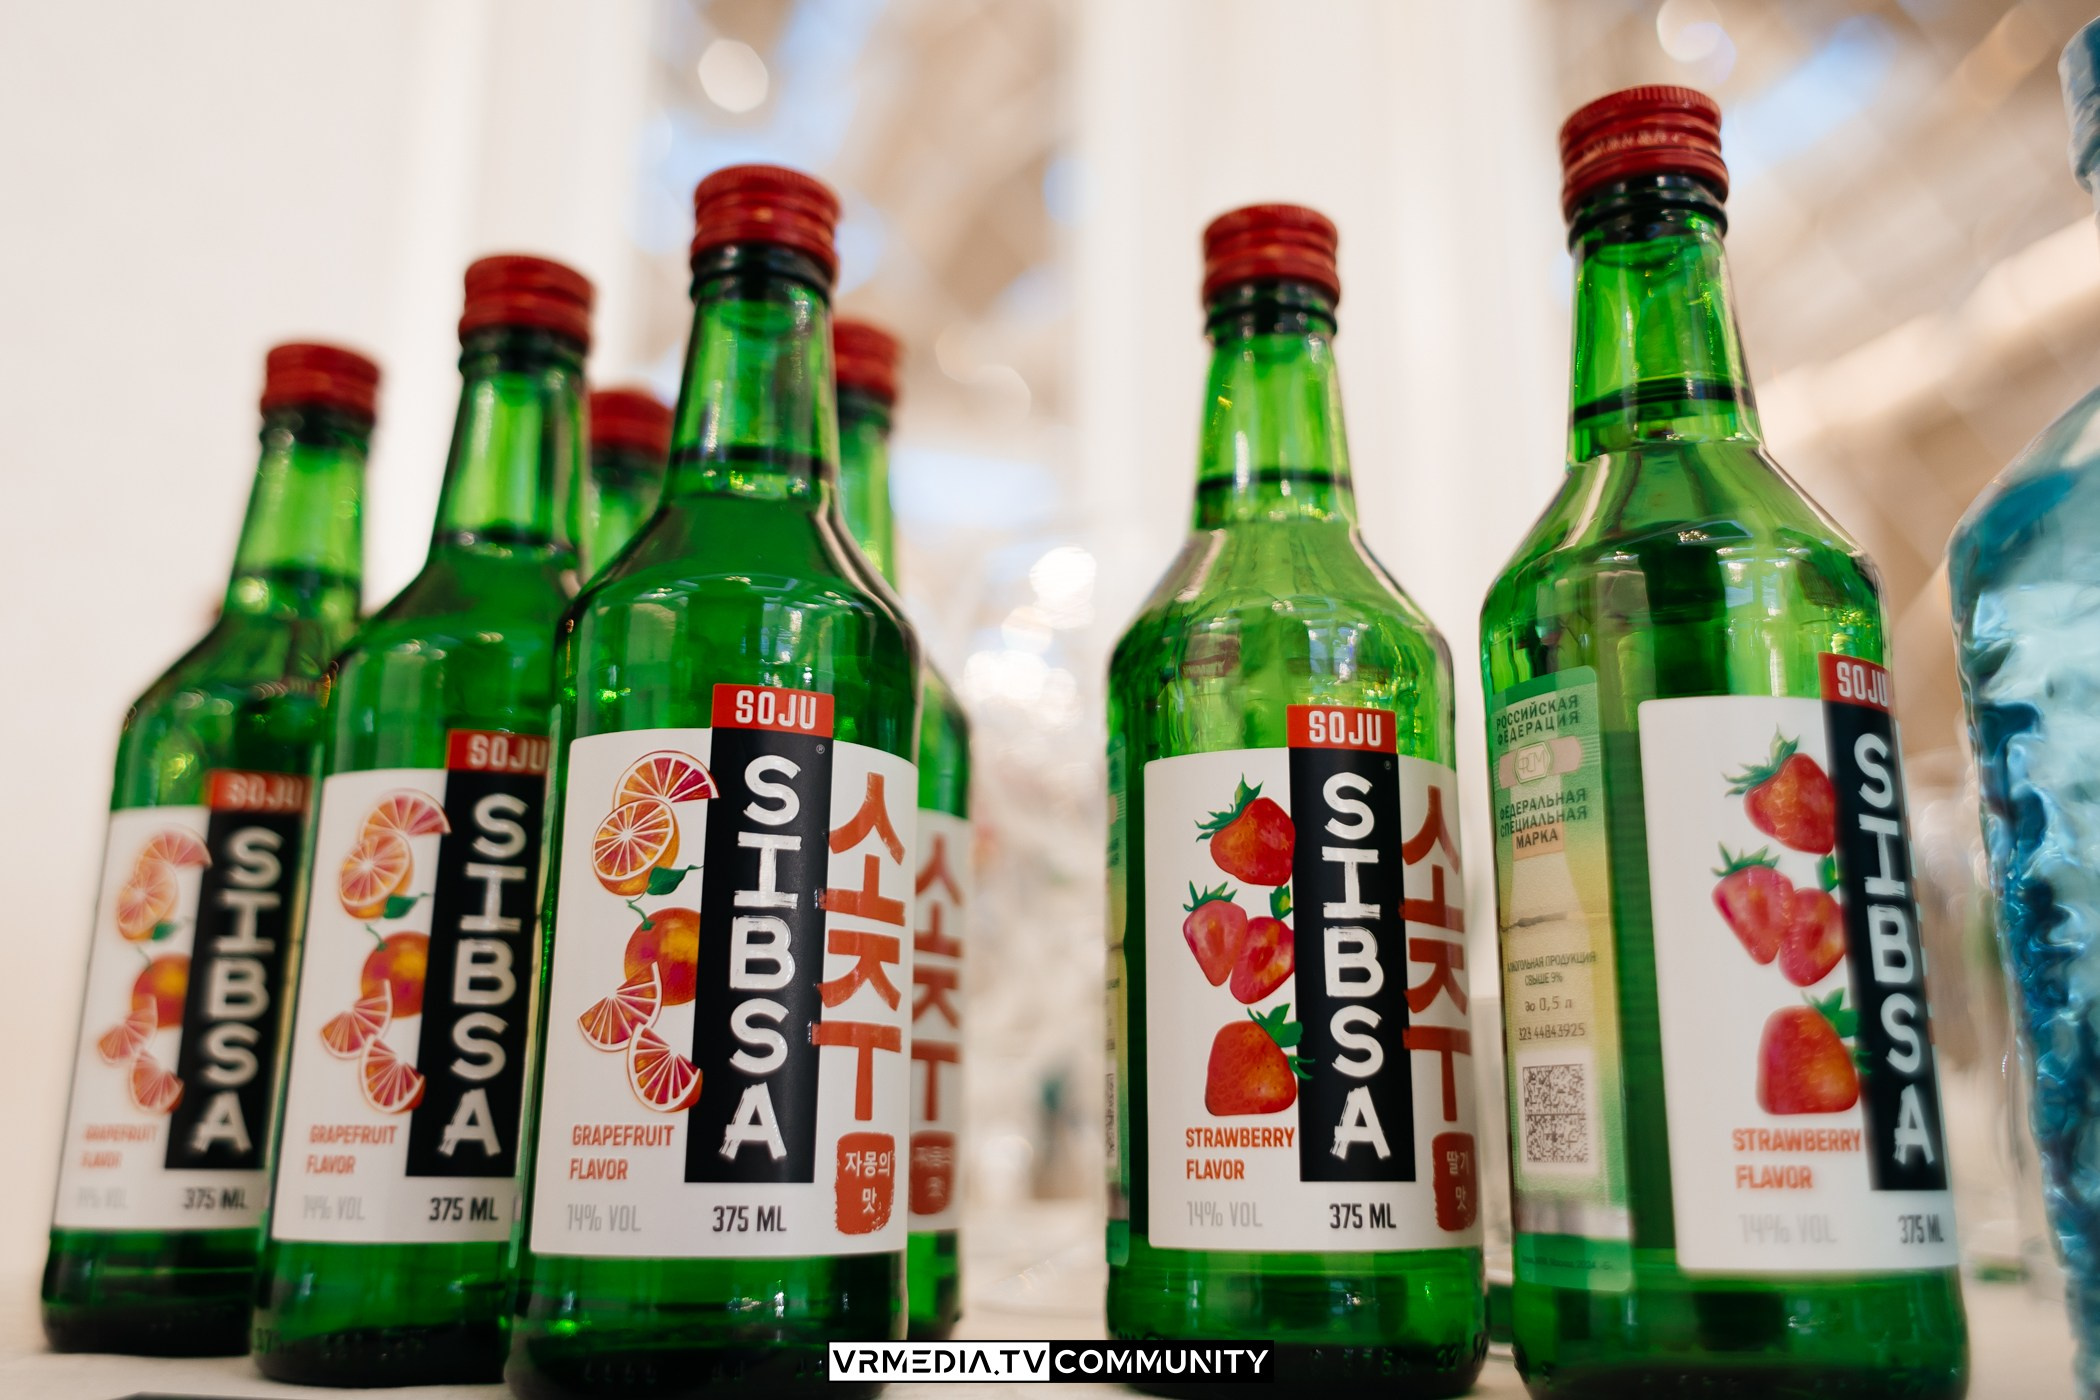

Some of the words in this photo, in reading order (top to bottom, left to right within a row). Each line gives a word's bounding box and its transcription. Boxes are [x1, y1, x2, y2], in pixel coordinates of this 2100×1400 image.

[1836, 661, 1889, 708] SOJU
[735, 690, 817, 729] SOJU
[1496, 695, 1579, 731] РОССИЙСКАЯ
[1308, 711, 1381, 746] SOJU
[1497, 711, 1579, 745] ФЕДЕРАЦИЯ
[467, 733, 549, 771] SOJU
[1500, 788, 1586, 820] ФЕДЕРАЛЬНАЯ
[1500, 805, 1587, 837] СПЕЦИАЛЬНАЯ
[1516, 828, 1558, 849] МАРКА
[719, 754, 801, 1162] SIBSA
[812, 772, 905, 1121] 소주
[1401, 785, 1471, 1122] 소주
[1855, 733, 1936, 1165] SIBSA
[438, 793, 529, 1156] SIBSA
[1322, 772, 1391, 1159] SIBSA
[190, 827, 285, 1152] SIBSA
[1539, 996, 1559, 1011] 0,5
[309, 1125, 398, 1144] GRAPEFRUIT
[572, 1124, 675, 1147] GRAPEFRUIT
[1185, 1127, 1295, 1148] STRAWBERRY
[1732, 1128, 1861, 1152] STRAWBERRY
[306, 1155, 355, 1174] FLAVOR
[570, 1158, 628, 1180] FLAVOR
[845, 1151, 891, 1177] 자몽의
[1186, 1159, 1245, 1180] FLAVOR
[1736, 1165, 1813, 1189] FLAVOR
[337, 1197, 365, 1220] VOL
[429, 1197, 463, 1221] 375
[470, 1198, 498, 1221] ML
[862, 1187, 877, 1213] 맛
[567, 1204, 602, 1231] 14%
[608, 1205, 642, 1232] VOL
[712, 1205, 750, 1232] 375
[755, 1206, 787, 1232] ML
[1187, 1201, 1223, 1227] 14%
[1229, 1203, 1263, 1228] VOL
[1329, 1203, 1363, 1228] 375
[1369, 1204, 1397, 1229] ML
[1898, 1214, 1925, 1244] 375
[1927, 1214, 1944, 1243] ML
